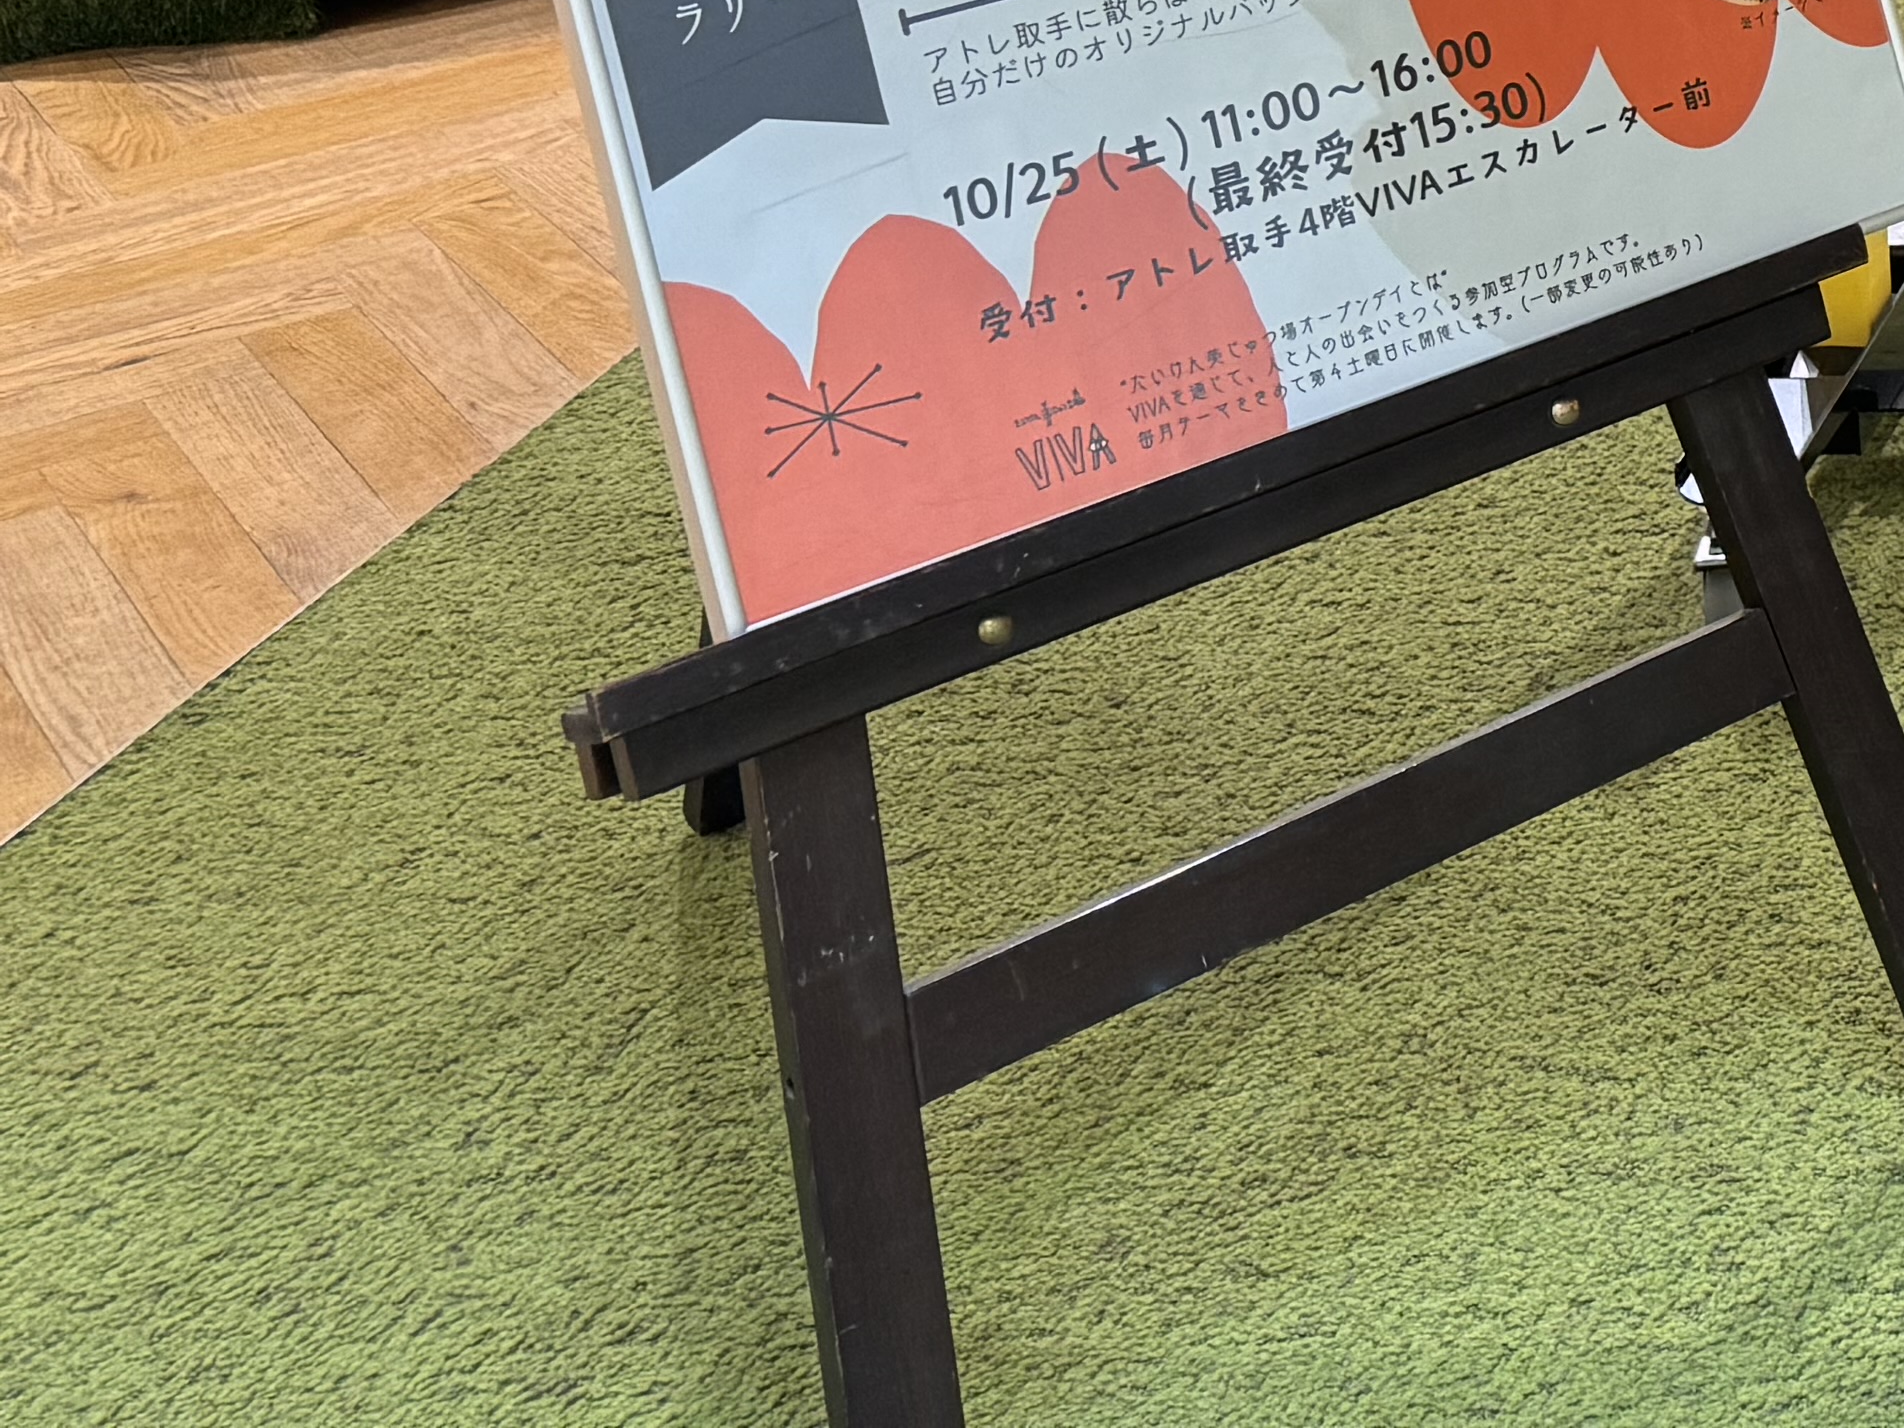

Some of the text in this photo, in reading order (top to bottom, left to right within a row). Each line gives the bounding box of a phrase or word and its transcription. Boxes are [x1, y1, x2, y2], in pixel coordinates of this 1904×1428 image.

[1187, 72, 1547, 230] (最終受付15:30)
[1015, 423, 1117, 490] VIVA
